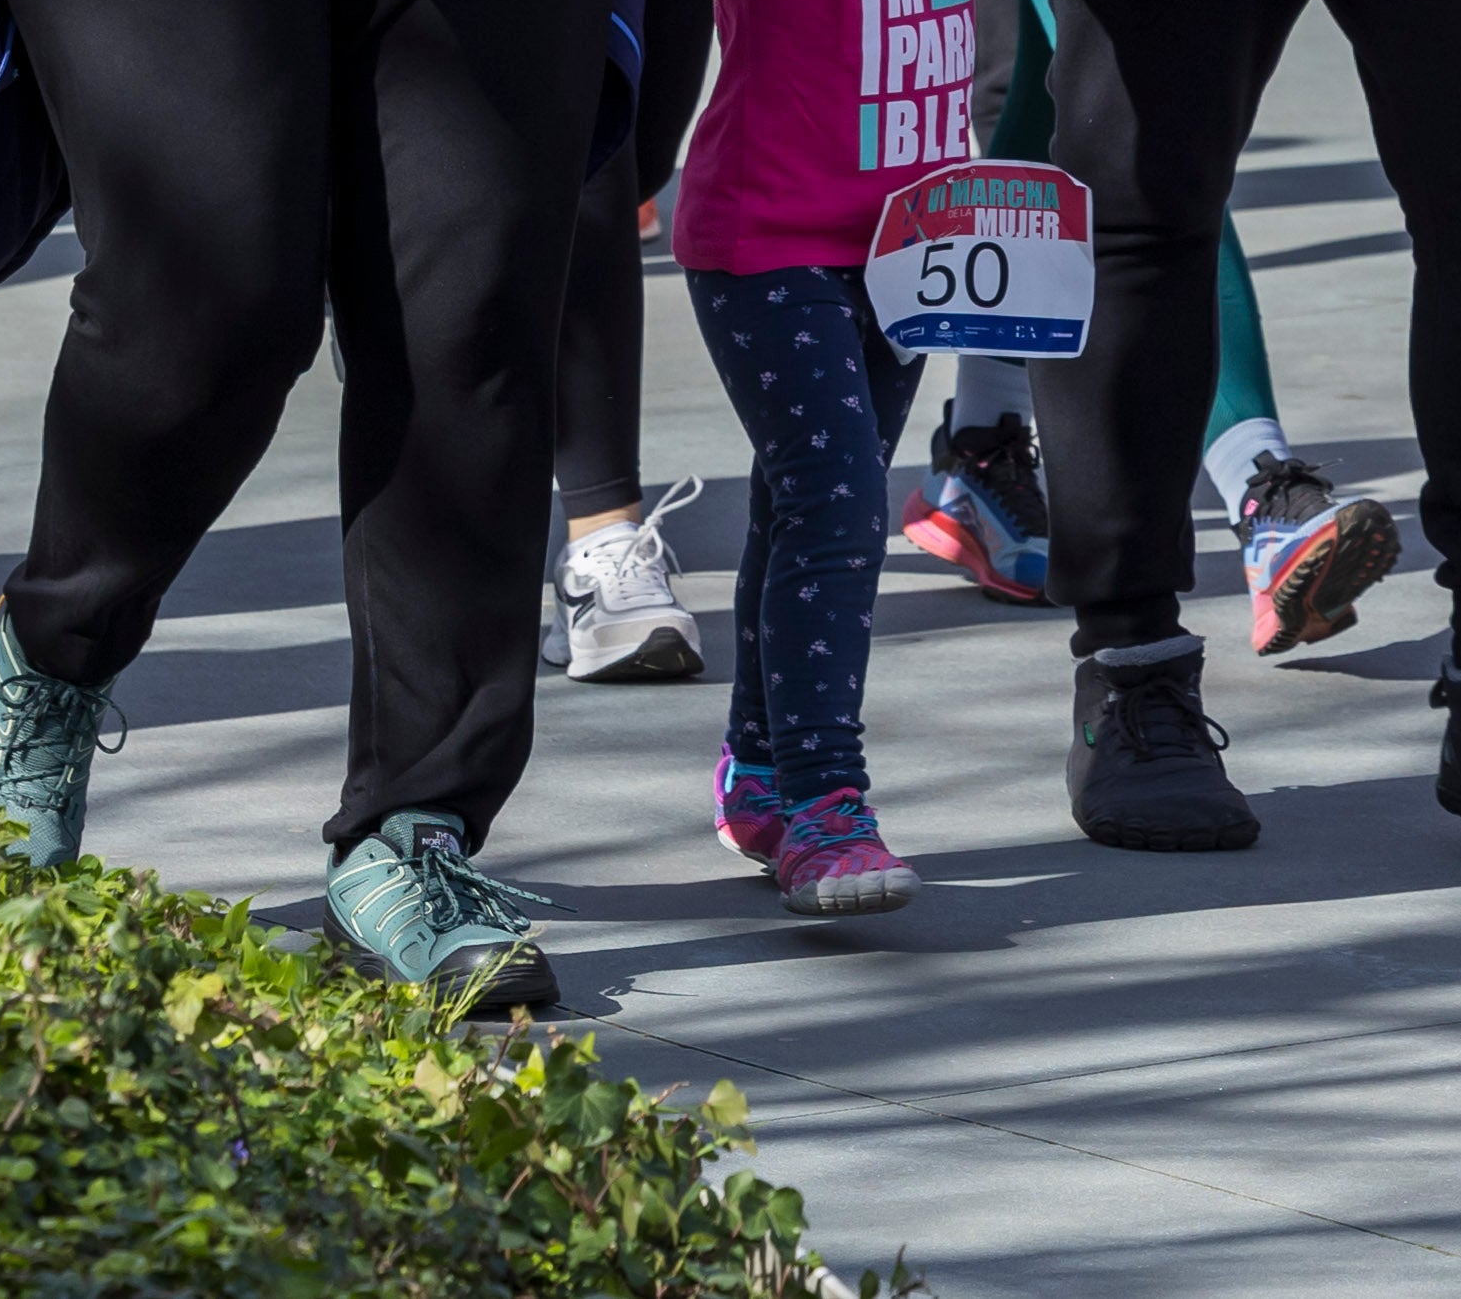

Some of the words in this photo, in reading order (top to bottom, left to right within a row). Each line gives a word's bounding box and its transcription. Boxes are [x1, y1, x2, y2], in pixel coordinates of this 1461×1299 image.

[928, 184, 946, 213] VI
[951, 178, 1060, 210] MARCHA
[974, 208, 1060, 240] MUJER
[917, 241, 1009, 308] 50
